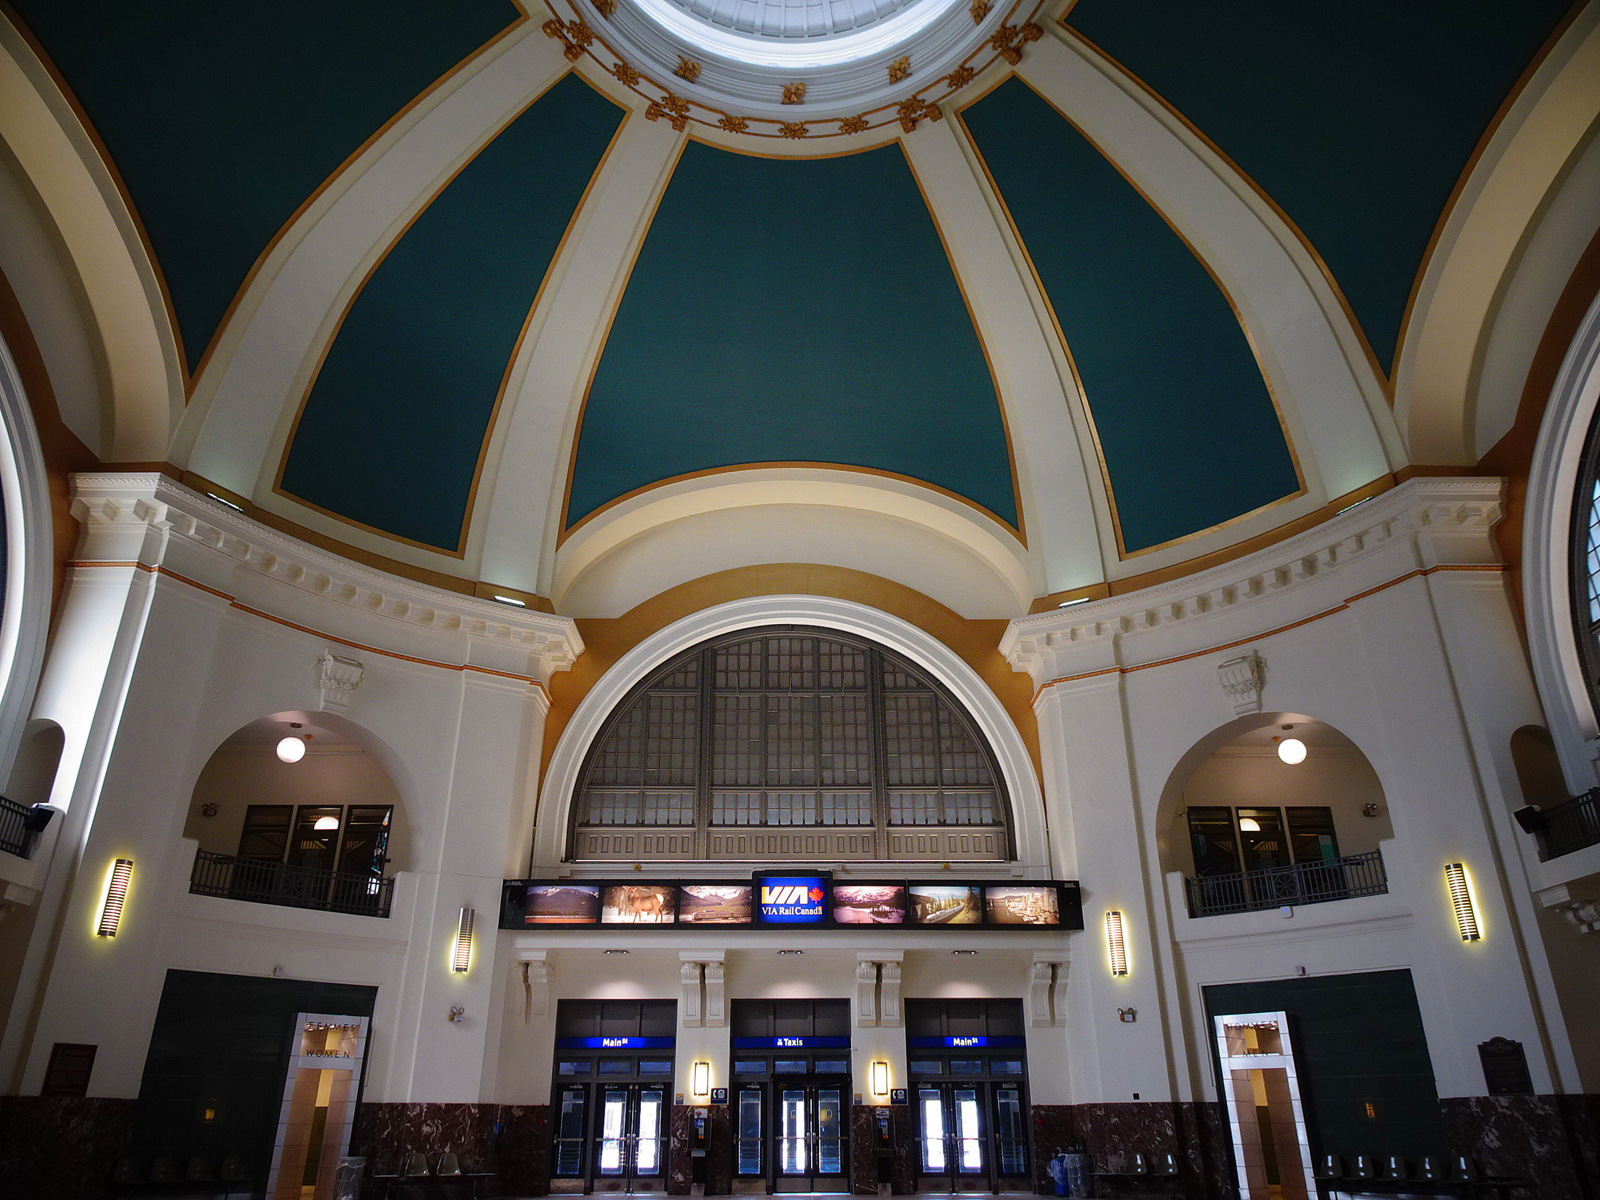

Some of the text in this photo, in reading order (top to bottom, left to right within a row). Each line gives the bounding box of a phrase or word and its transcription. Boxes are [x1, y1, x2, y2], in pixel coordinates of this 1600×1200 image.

[761, 886, 808, 904] VIA
[762, 906, 823, 915] VIA Rail Canada
[309, 1021, 357, 1032] FEMMES
[1227, 1021, 1278, 1031] HOMMES
[602, 1038, 622, 1047] Main
[784, 1038, 803, 1046] Taxis
[953, 1037, 972, 1046] Main
[306, 1049, 351, 1058] WOMEN
[1242, 1049, 1269, 1058] MEN
